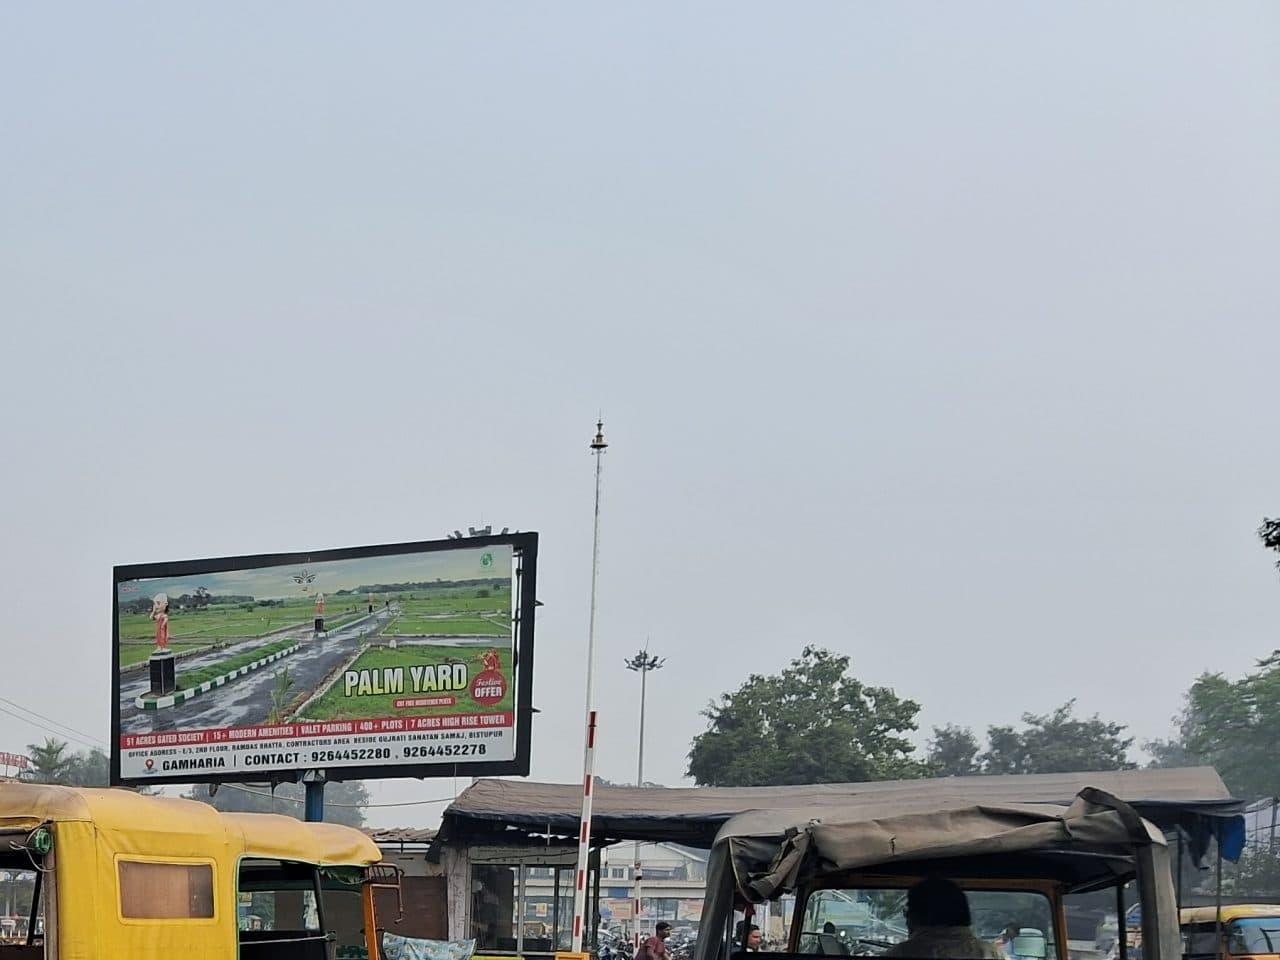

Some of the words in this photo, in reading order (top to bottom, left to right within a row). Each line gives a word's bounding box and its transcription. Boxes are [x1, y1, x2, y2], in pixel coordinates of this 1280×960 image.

[345, 667, 404, 697] PALM
[409, 662, 468, 693] YARD
[474, 687, 503, 698] OFFER
[476, 678, 502, 687] Festive
[127, 737, 135, 746] 51
[136, 735, 155, 746] ACRES
[157, 733, 177, 744] GATED
[178, 732, 204, 743] SOCIETY
[228, 728, 256, 739] MODERN
[258, 726, 294, 738] AMENITIES
[301, 723, 320, 736] VALET
[323, 722, 352, 733] PARKING
[381, 719, 403, 730] PLOTS
[411, 718, 415, 728] 7
[417, 716, 441, 728] ACRES
[442, 716, 460, 726] HIGH
[461, 715, 478, 725] RISE
[480, 714, 505, 725] TOWER
[150, 749, 177, 757] ADDRESS
[286, 739, 331, 748] CONTRACTORS
[378, 735, 406, 743] GUJRATI
[408, 733, 439, 742] SANATAN
[469, 730, 503, 739] BISTUPUR
[162, 756, 225, 771] GAMHARIA
[244, 752, 300, 766] CONTACT
[312, 748, 391, 762] 9264452280
[404, 744, 487, 758] 9264452278
